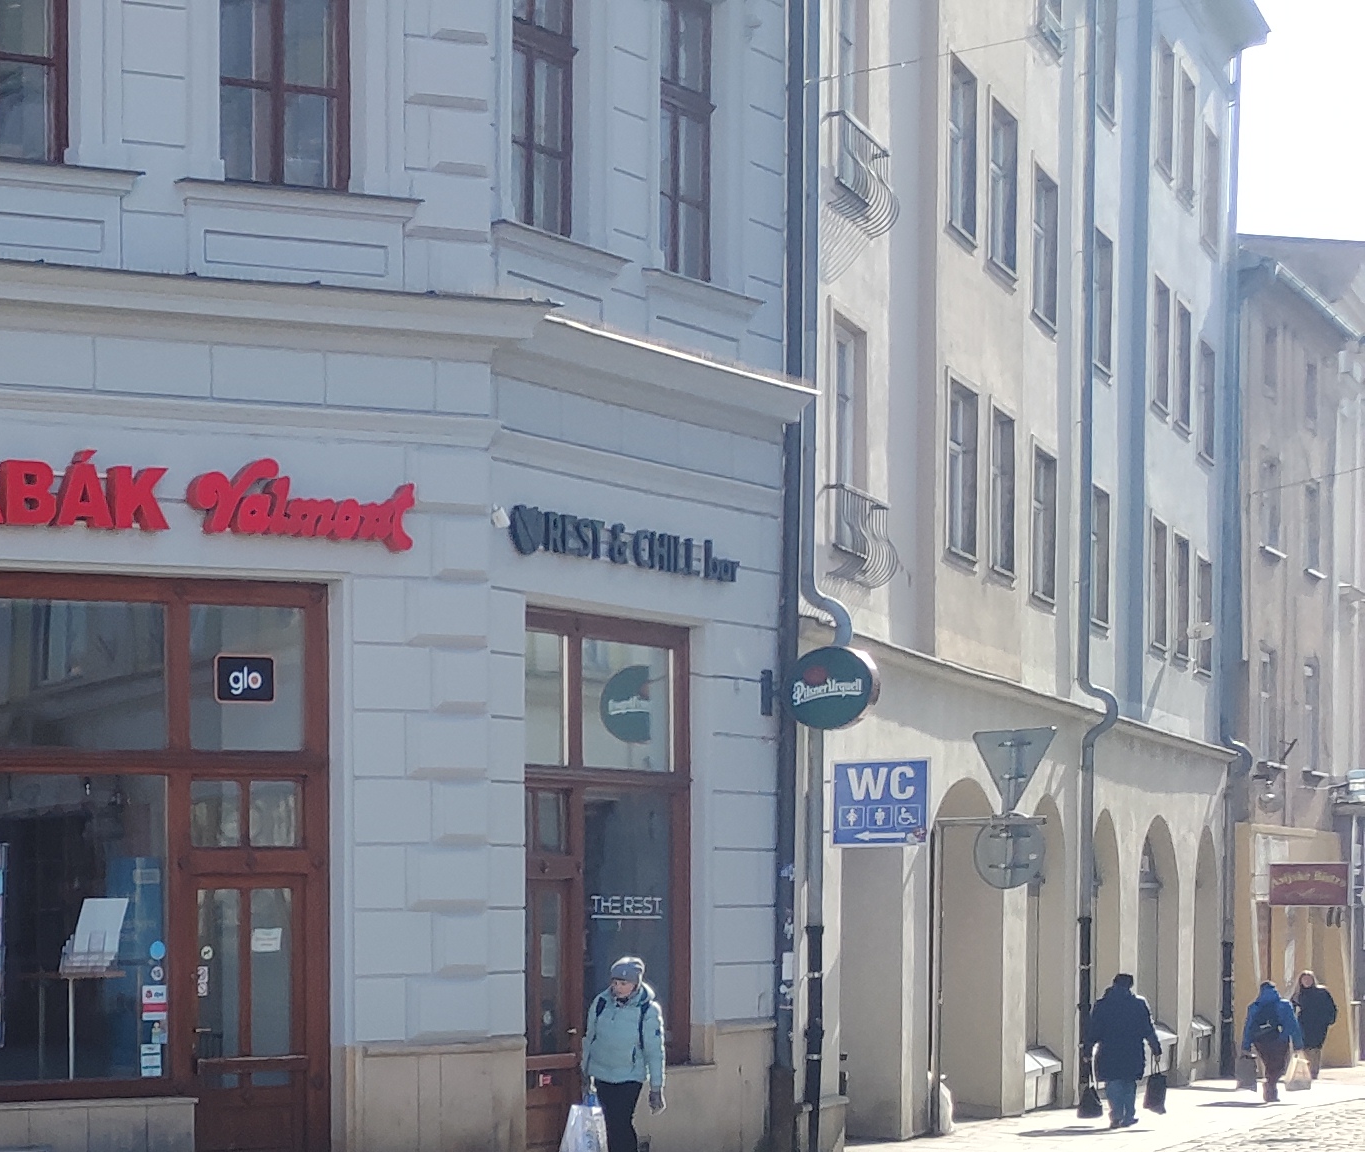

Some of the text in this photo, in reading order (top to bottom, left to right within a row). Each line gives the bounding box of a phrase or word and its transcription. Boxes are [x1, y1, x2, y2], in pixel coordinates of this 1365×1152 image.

[187, 457, 416, 553] Valmont
[544, 511, 740, 582] REST & CHILL bar
[229, 665, 263, 695] glo
[792, 677, 863, 706] Pilsner Urquell
[846, 765, 916, 801] WC
[590, 895, 621, 914] THE
